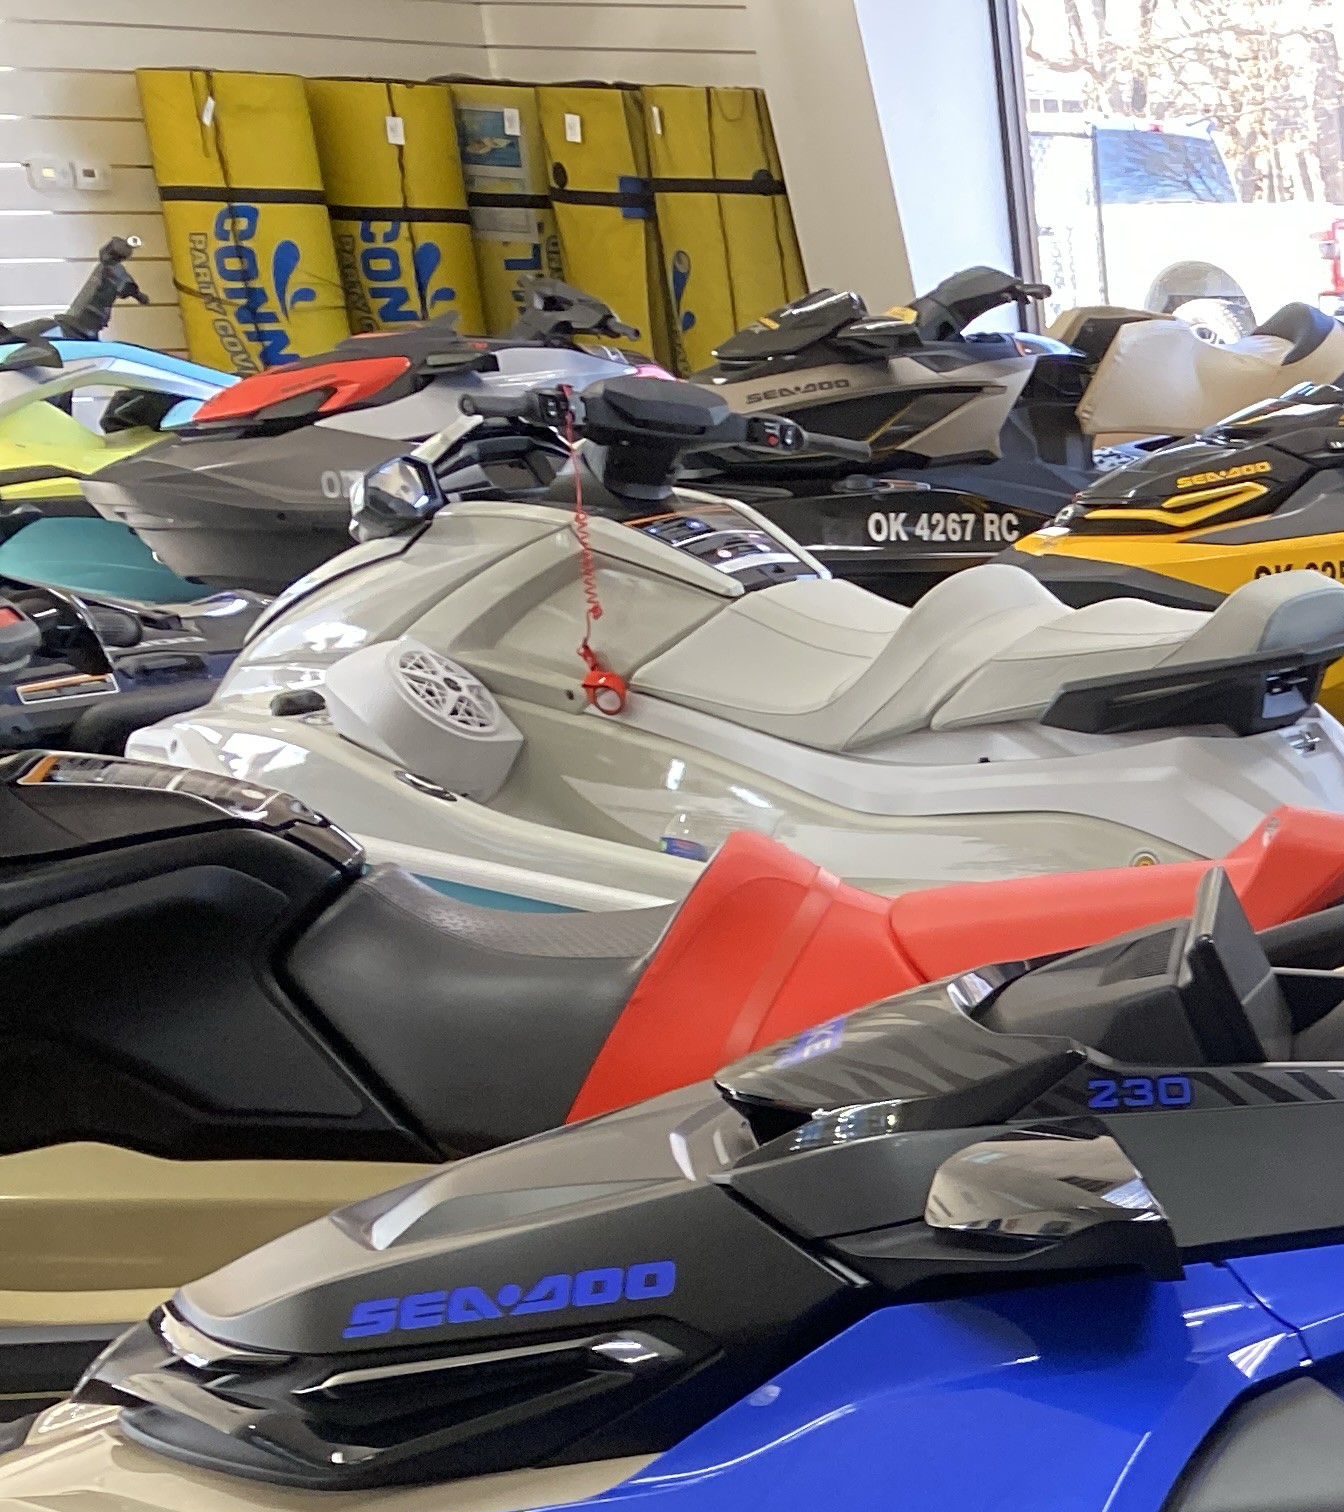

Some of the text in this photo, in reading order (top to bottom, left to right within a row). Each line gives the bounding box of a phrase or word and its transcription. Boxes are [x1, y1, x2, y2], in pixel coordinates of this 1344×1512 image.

[868, 512, 1019, 542] OK 4267 RC
[1087, 1076, 1191, 1108] 230
